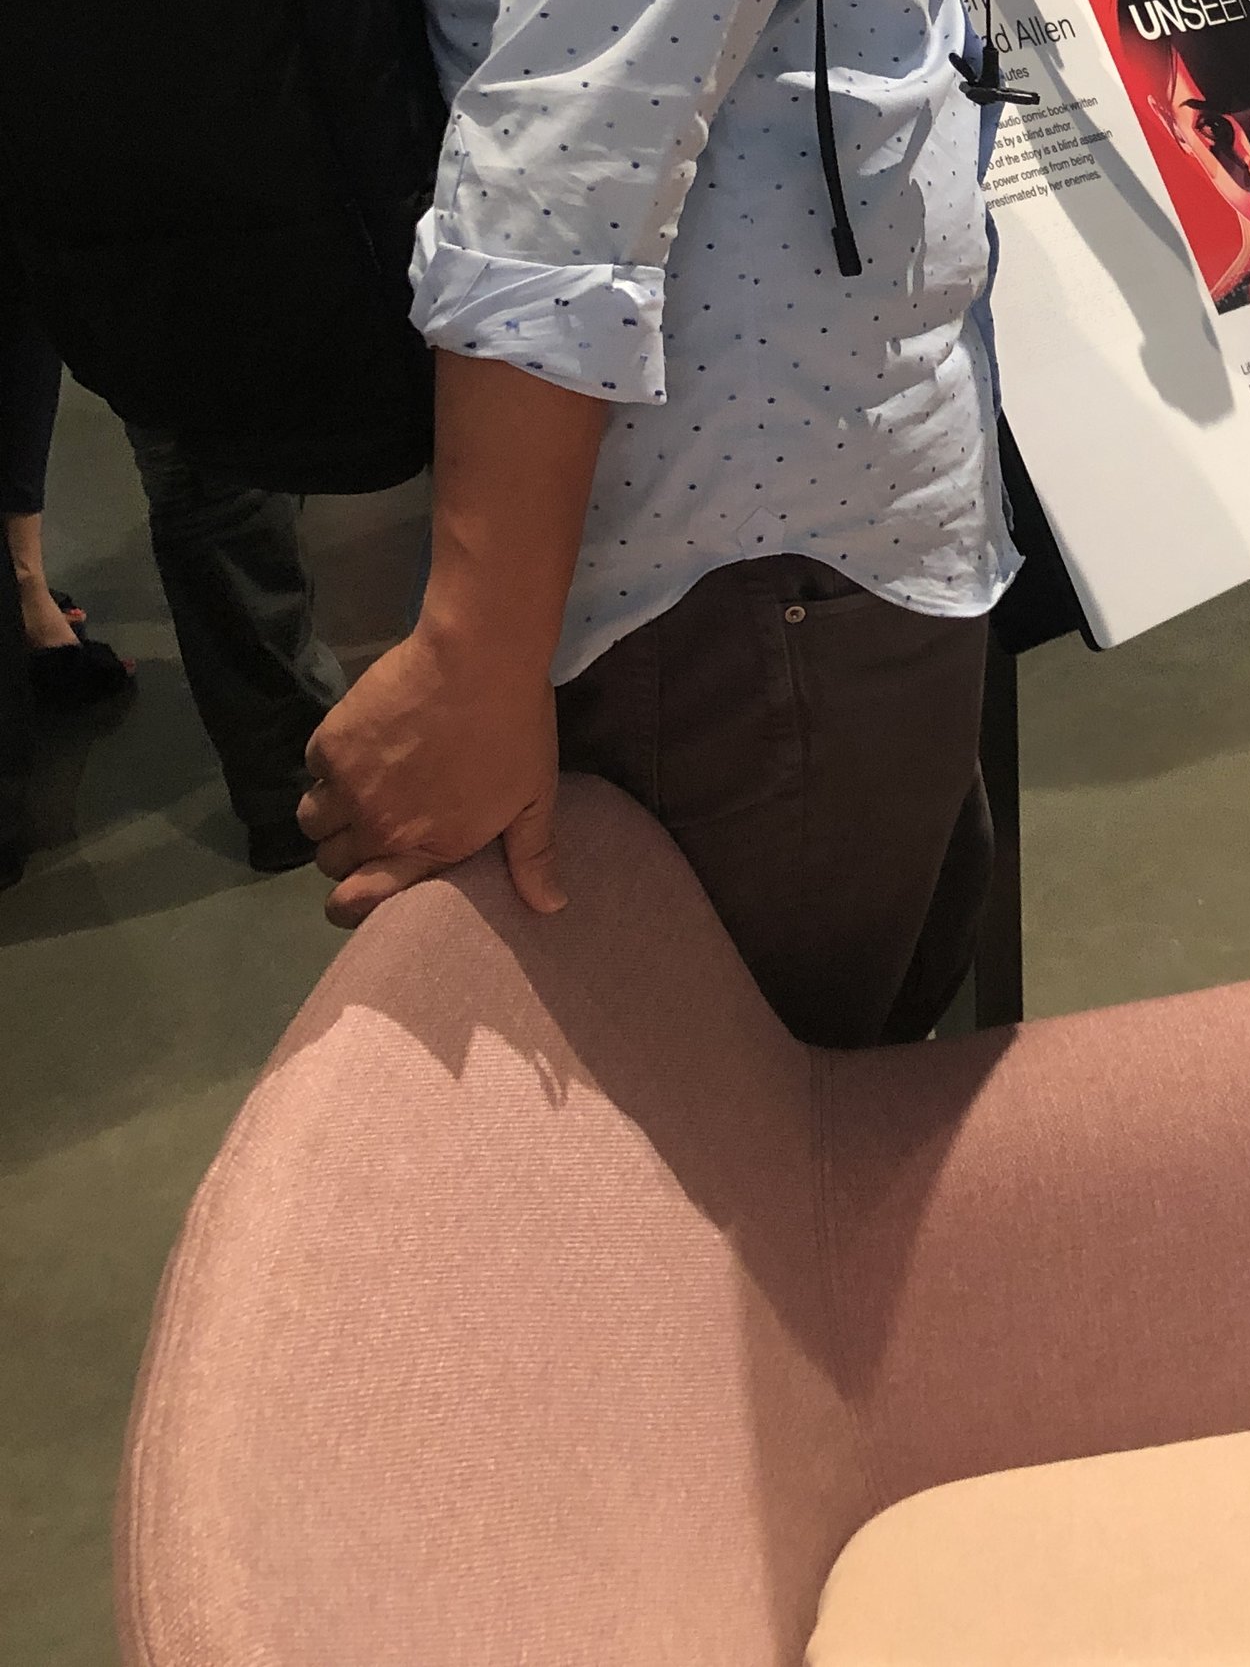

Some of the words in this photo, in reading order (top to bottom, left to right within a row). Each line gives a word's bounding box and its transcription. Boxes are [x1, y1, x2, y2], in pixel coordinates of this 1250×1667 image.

[1017, 16, 1076, 50] Allen
[1004, 67, 1030, 83] utes
[1022, 109, 1048, 124] comic
[1047, 102, 1069, 116] book
[1069, 97, 1098, 111] written
[995, 156, 1005, 168] of
[1005, 154, 1020, 166] the
[1021, 149, 1043, 162] story
[1043, 146, 1051, 155] is
[1052, 144, 1058, 153] a
[1057, 136, 1079, 151] blind
[1080, 129, 1113, 145] assassin
[1003, 136, 1016, 149] by
[1017, 135, 1023, 143] a
[1022, 127, 1044, 142] blind
[1044, 122, 1075, 136] author.
[992, 175, 1020, 191] power
[1021, 166, 1050, 181] comes
[1049, 159, 1071, 173] from
[1069, 153, 1096, 167] being
[985, 186, 1038, 210] erestimated
[1036, 184, 1048, 197] by
[1048, 180, 1063, 191] her
[1064, 170, 1102, 187] enemies.
